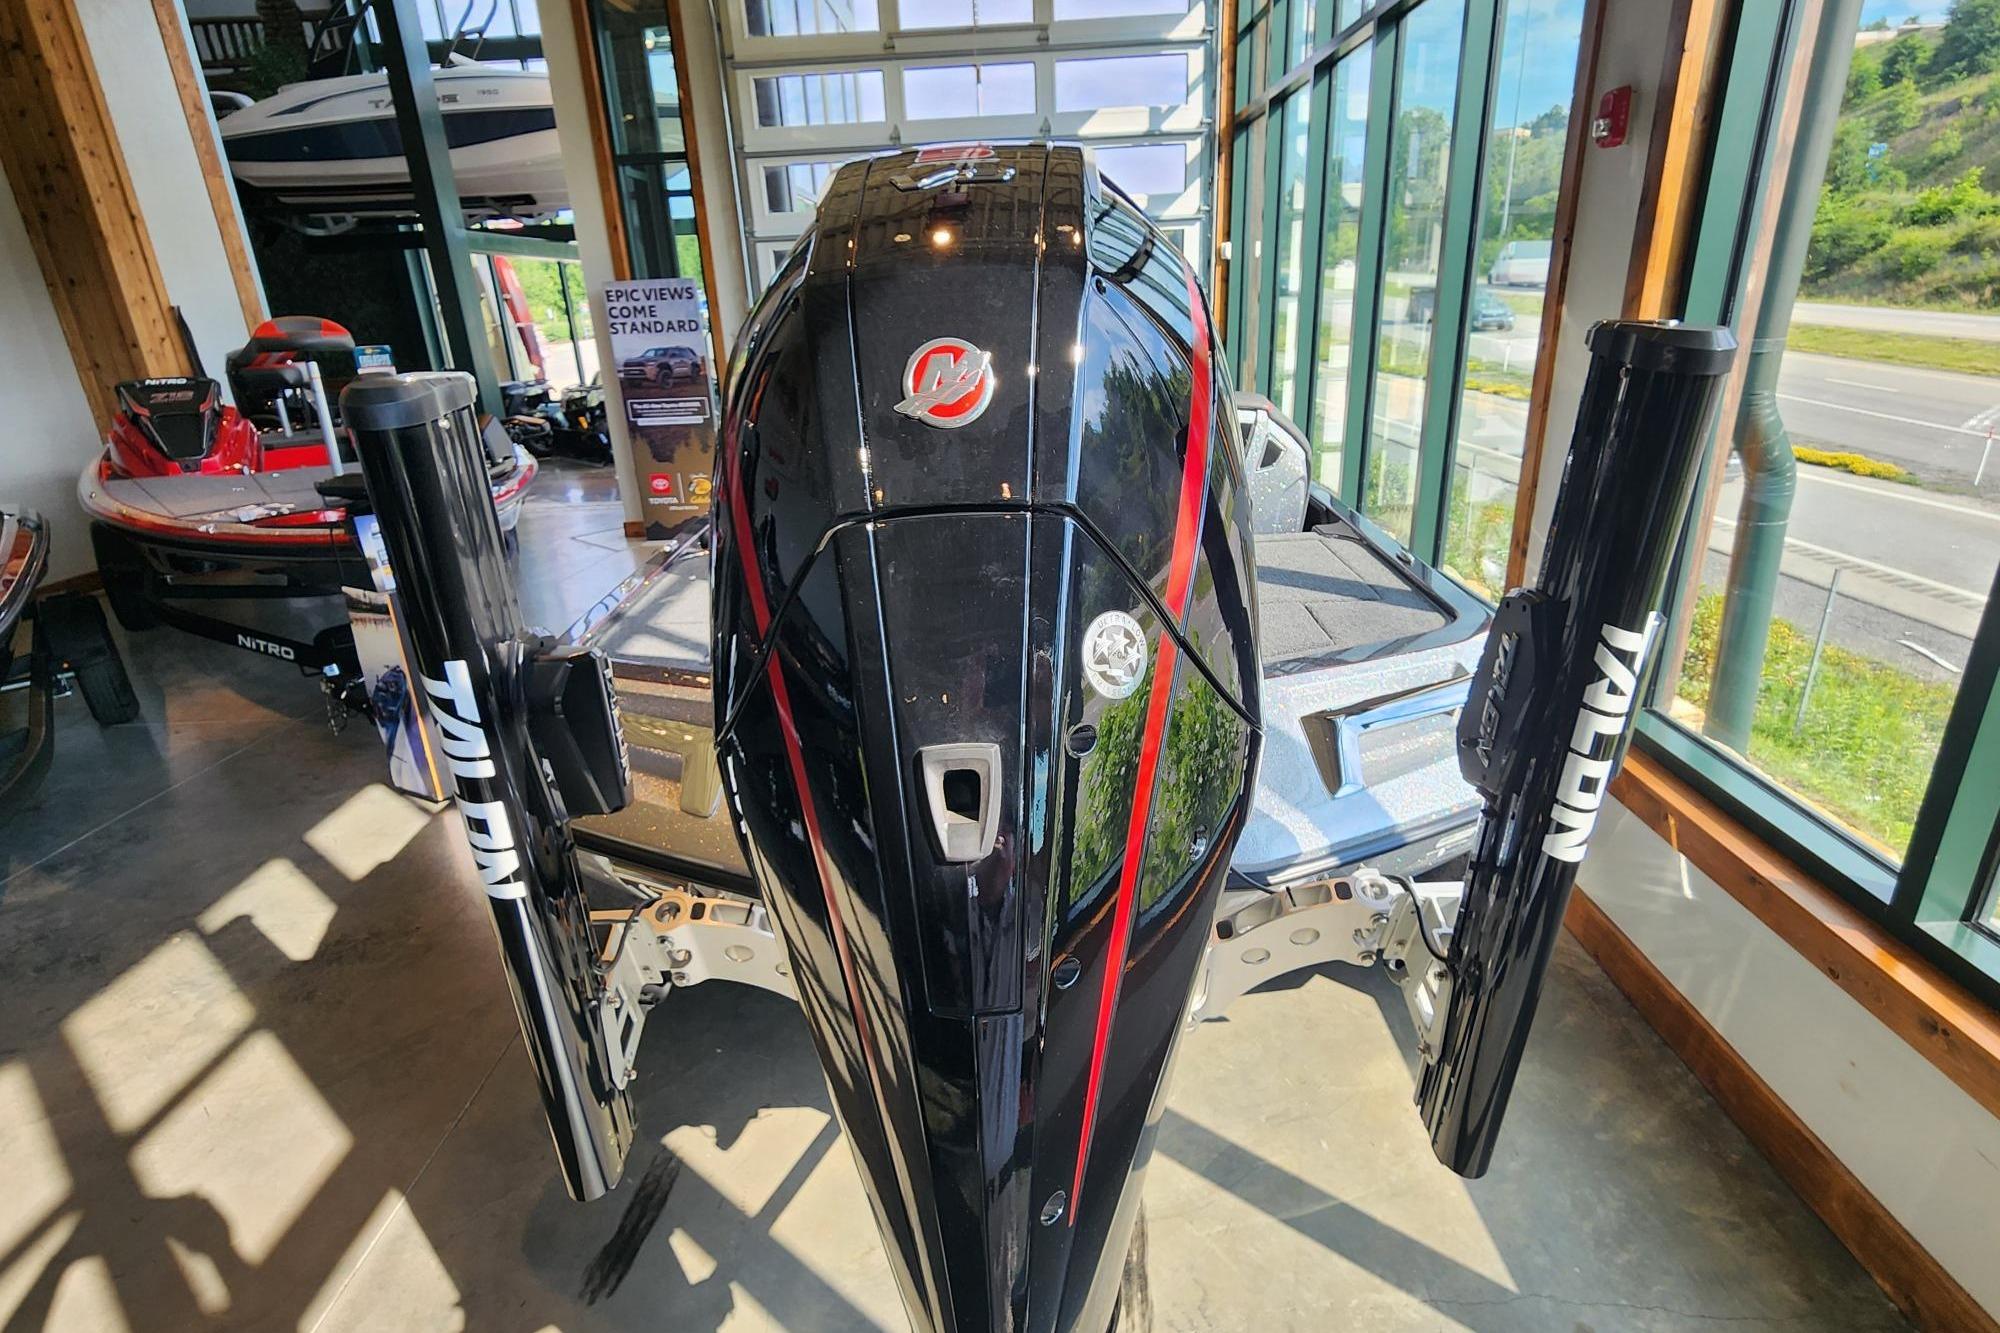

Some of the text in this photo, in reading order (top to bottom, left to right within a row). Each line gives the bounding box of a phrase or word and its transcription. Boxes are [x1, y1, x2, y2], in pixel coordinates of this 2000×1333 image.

[606, 286, 694, 302] EPIC VIEWS
[608, 305, 657, 319] COME
[610, 319, 699, 334] STANDARD
[1542, 610, 1666, 862] TALON
[419, 659, 527, 899] TALON
